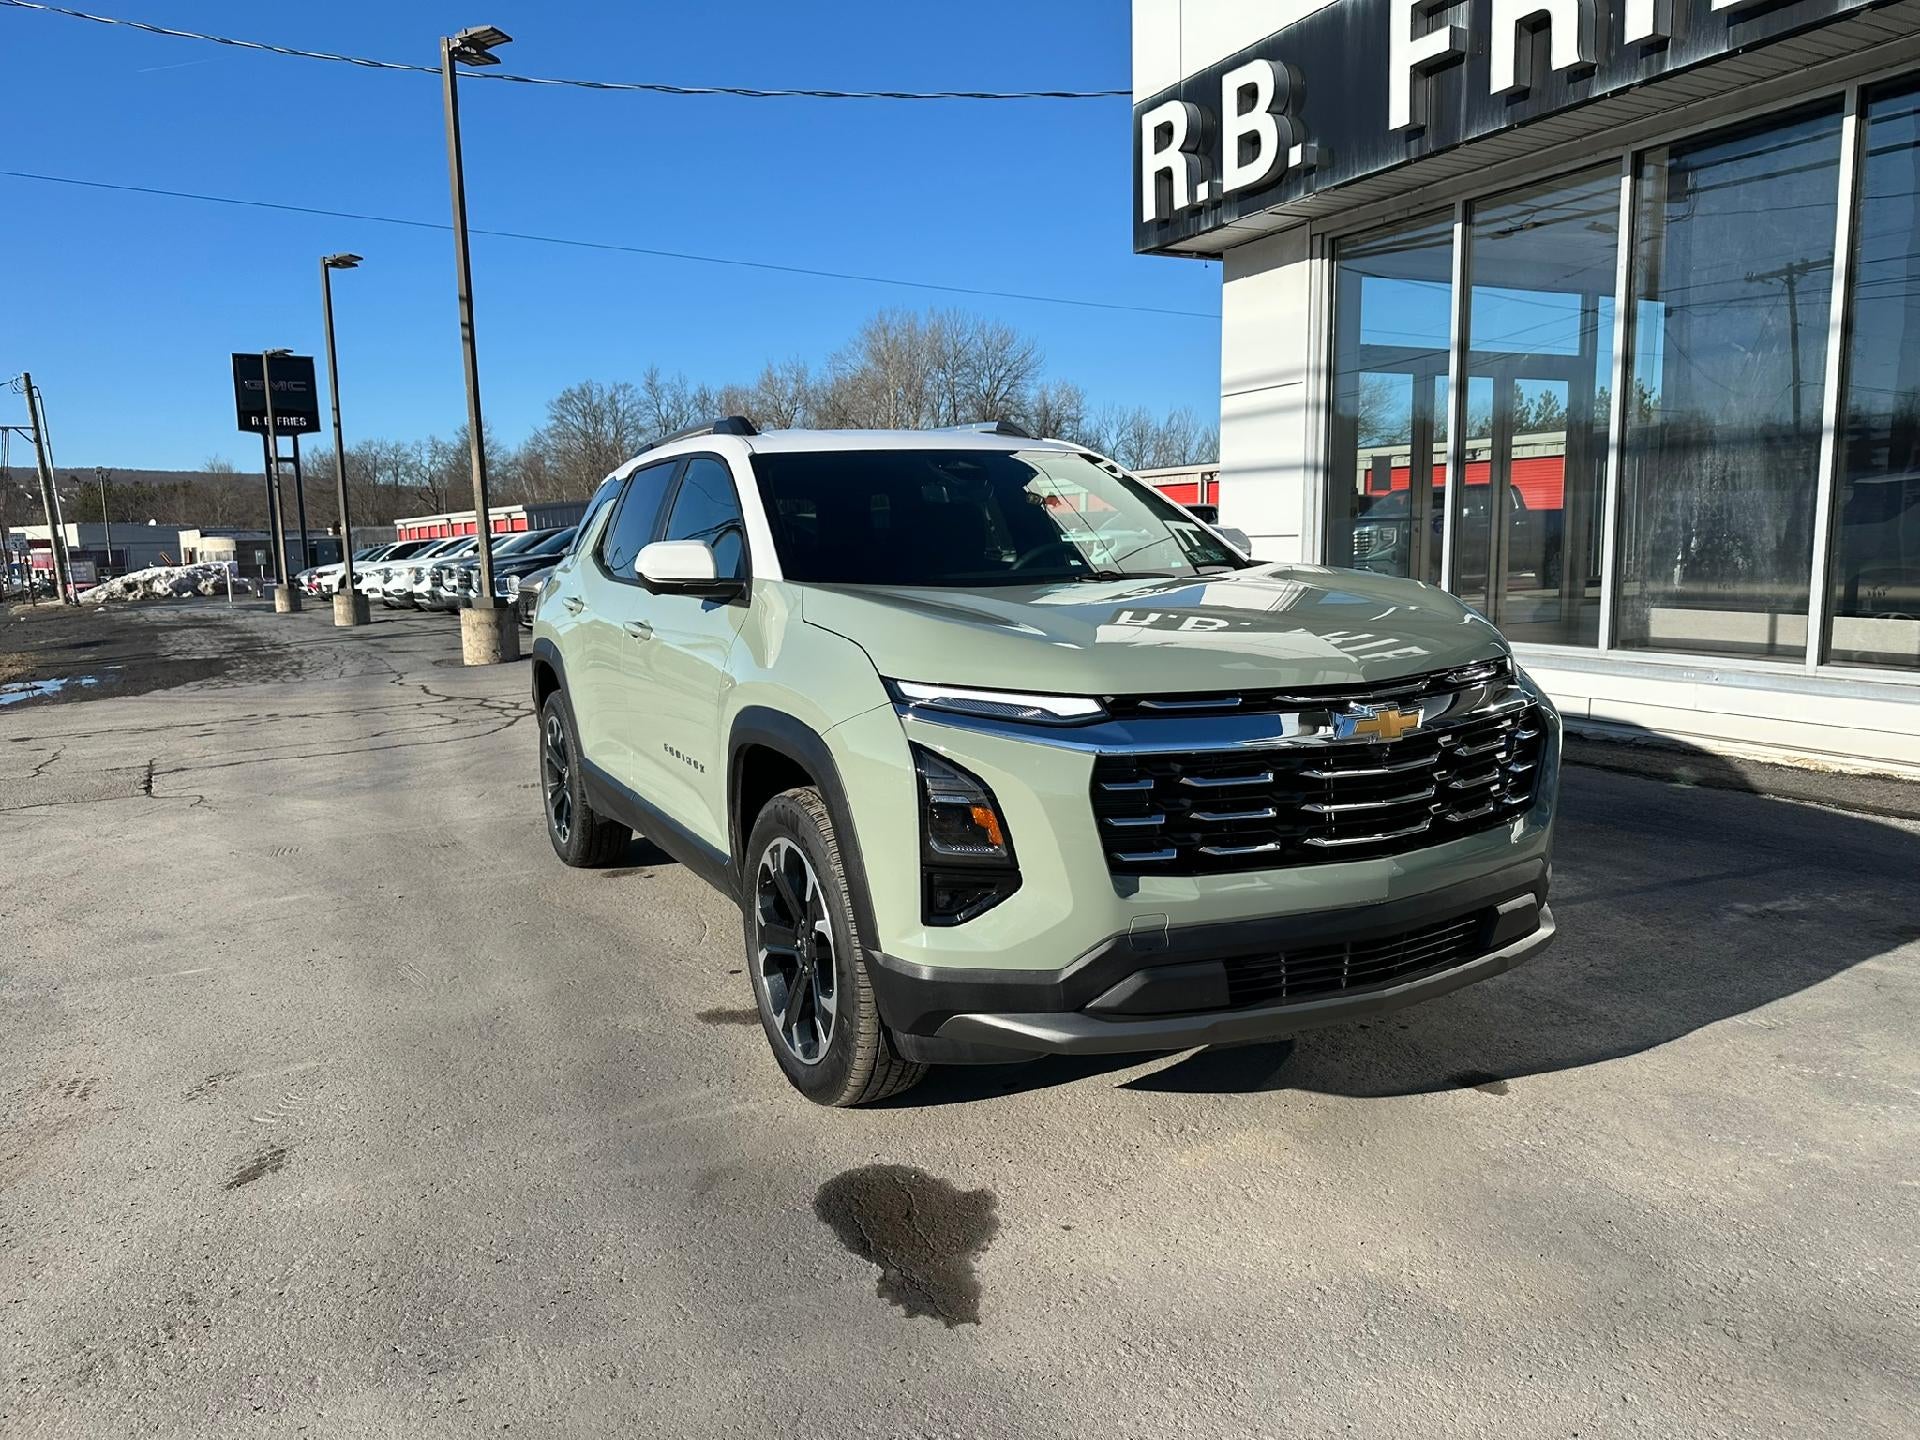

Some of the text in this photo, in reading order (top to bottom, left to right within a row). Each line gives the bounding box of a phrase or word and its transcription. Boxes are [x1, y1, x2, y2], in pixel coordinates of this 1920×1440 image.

[1142, 59, 1302, 223] R.B.
[245, 380, 307, 391] GMC
[276, 416, 307, 427] FRIES
